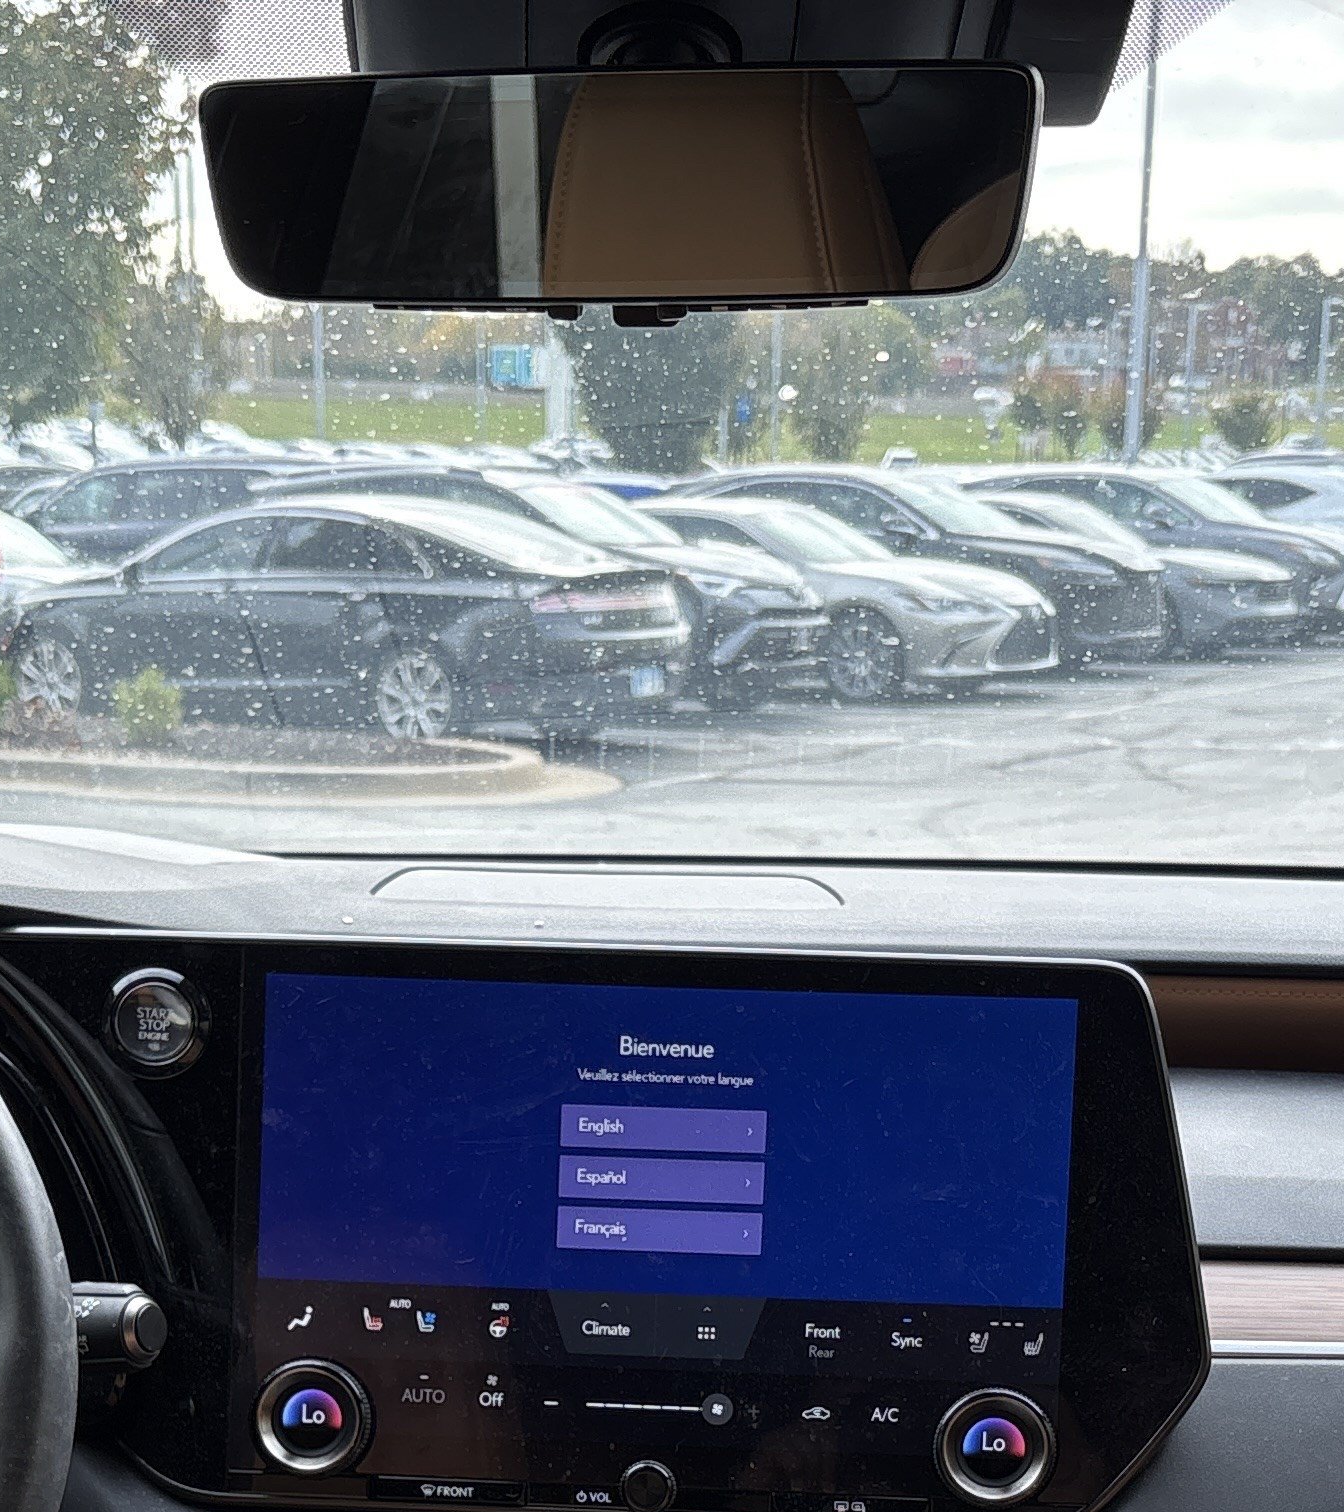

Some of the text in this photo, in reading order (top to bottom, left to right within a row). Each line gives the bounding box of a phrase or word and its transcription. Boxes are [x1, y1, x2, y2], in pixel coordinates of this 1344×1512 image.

[136, 1006, 174, 1020] START
[138, 1019, 171, 1031] STOP
[137, 1031, 170, 1041] ENGINE
[619, 1035, 716, 1059] Bienvenue
[576, 1067, 620, 1082] Veuillez
[687, 1074, 716, 1085] votre
[717, 1072, 754, 1089] langue
[578, 1117, 624, 1136] English
[576, 1167, 627, 1187] Español
[574, 1218, 627, 1239] Français
[389, 1298, 412, 1310] AUTO
[490, 1302, 510, 1311] AUTO
[581, 1320, 631, 1338] Climate
[804, 1323, 841, 1340] Front
[890, 1332, 923, 1350] Sync
[808, 1345, 835, 1359] Rear
[401, 1387, 446, 1405] AUTO
[478, 1391, 505, 1408] Off
[301, 1403, 326, 1425] Lo
[870, 1407, 900, 1424] A/C
[981, 1431, 1006, 1452] Lo
[436, 1485, 475, 1498] FRONT
[589, 1491, 612, 1503] VOL
